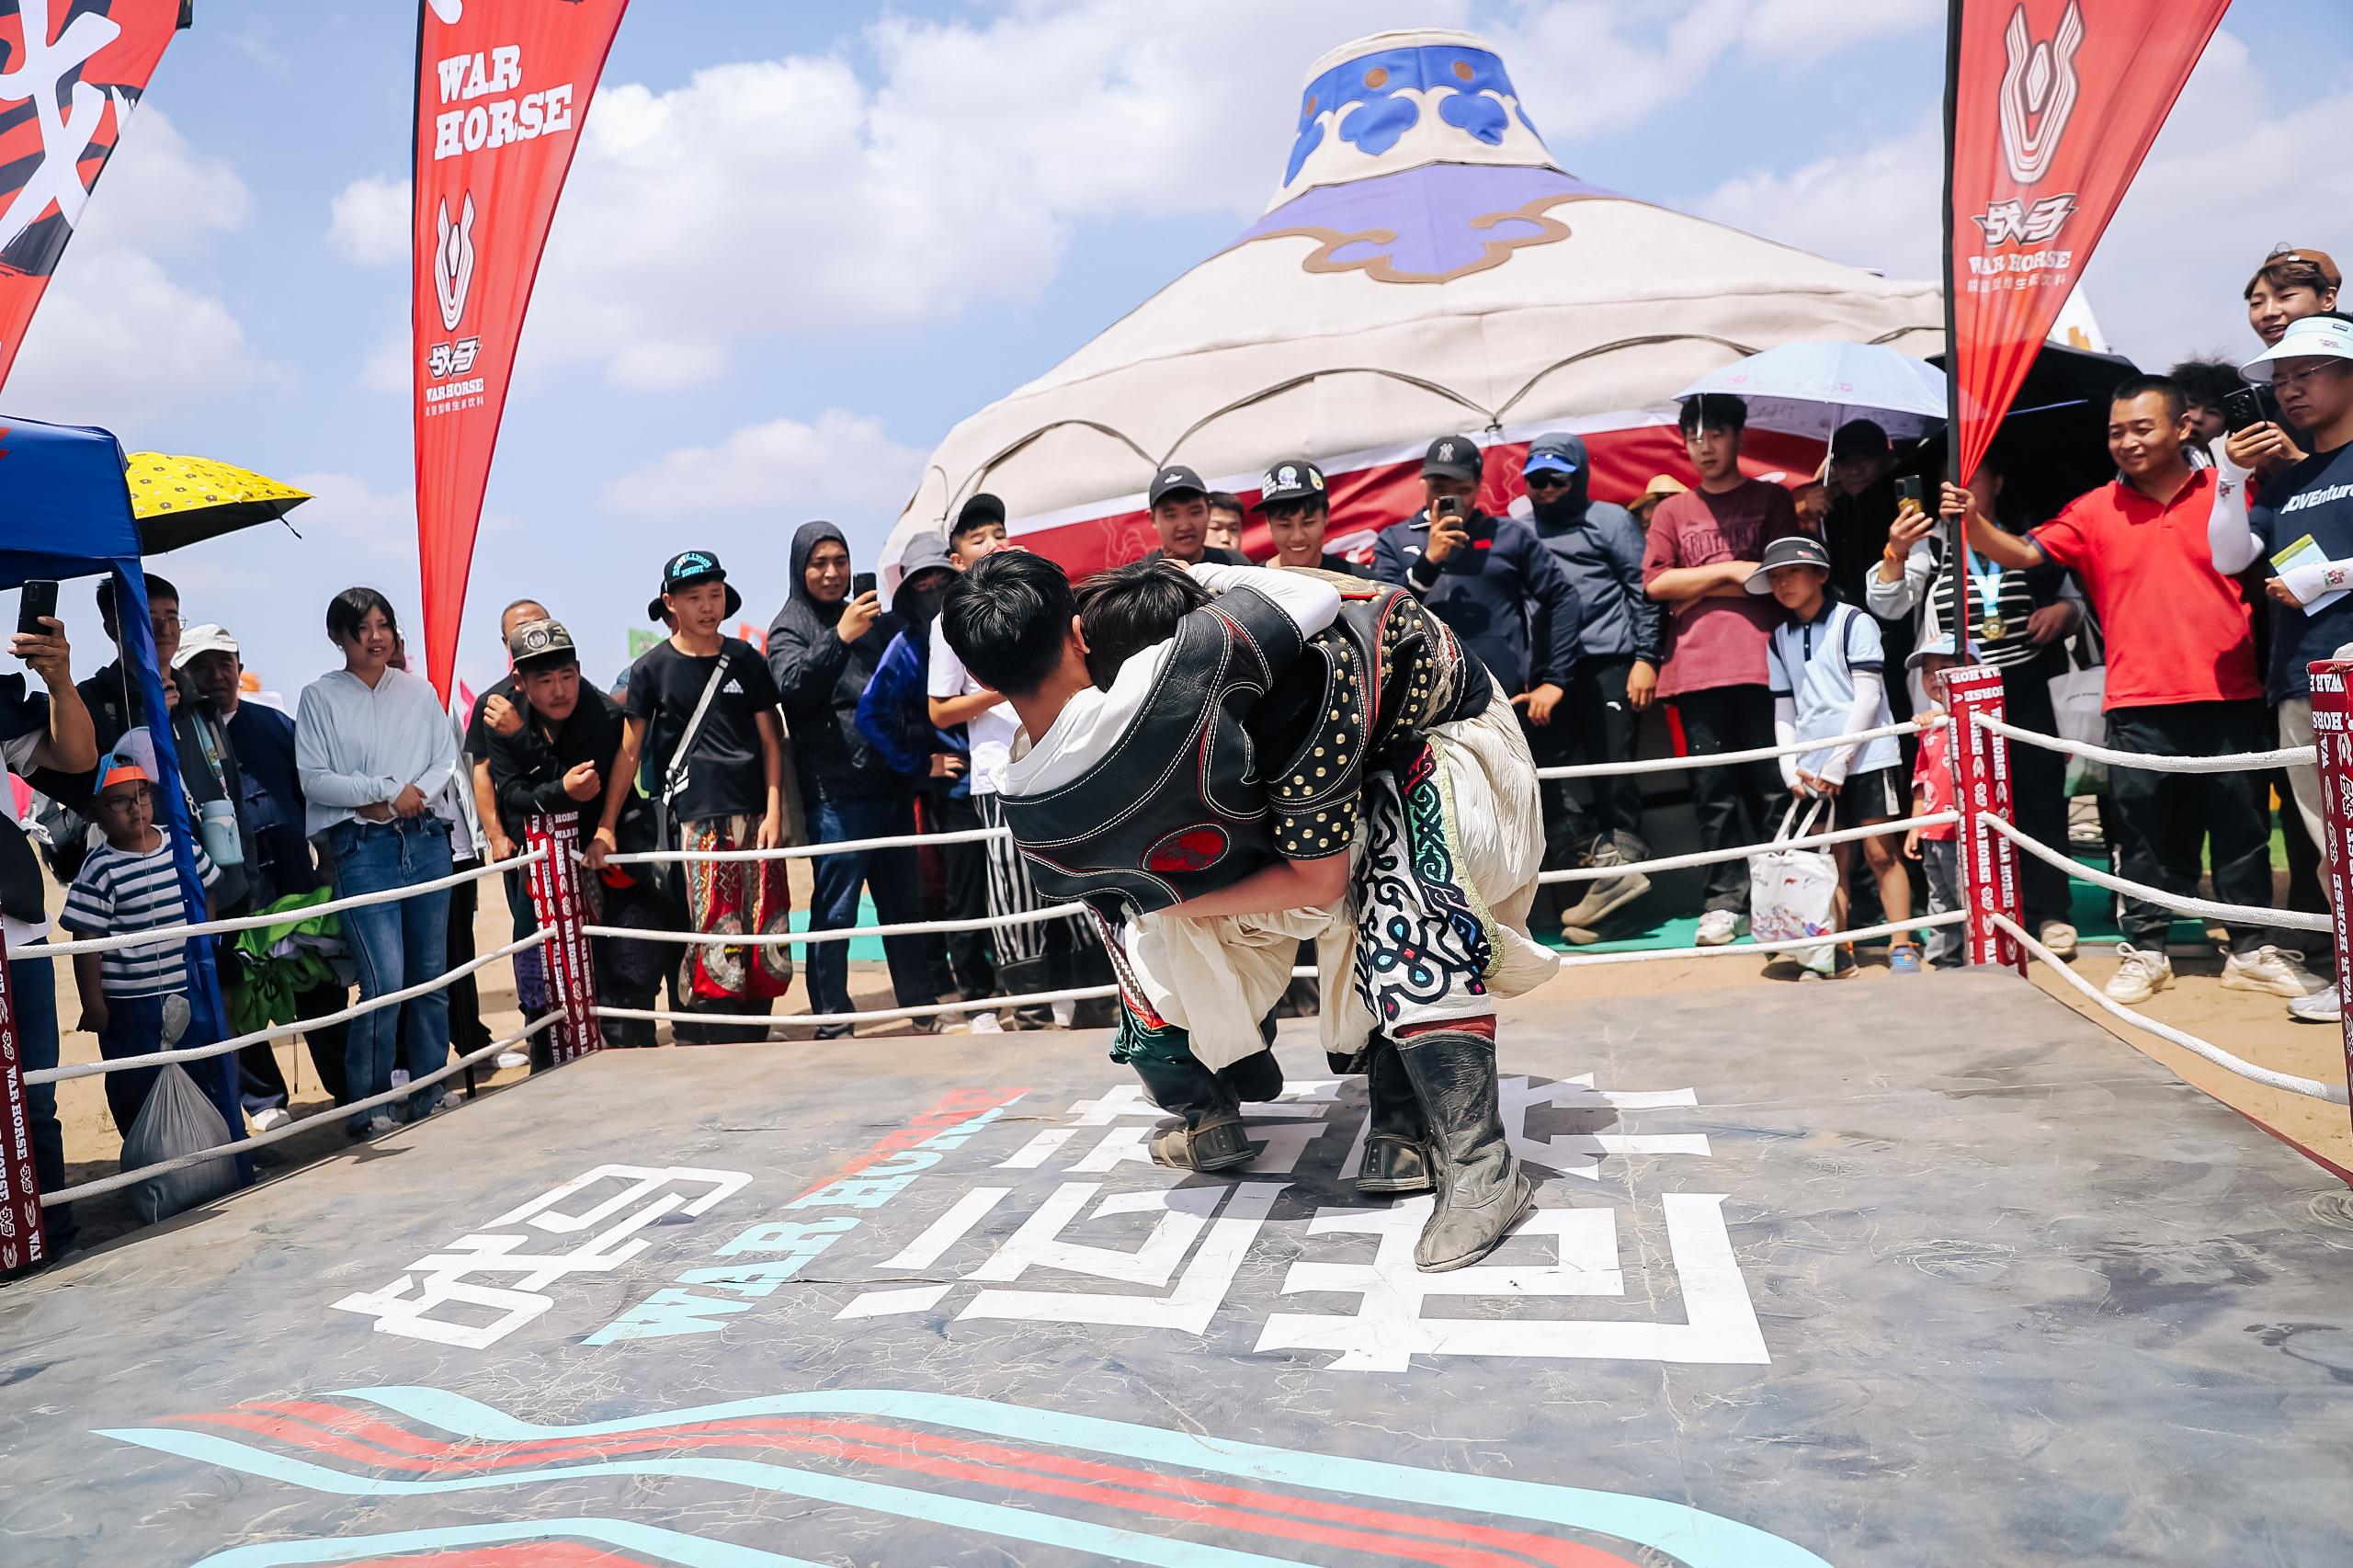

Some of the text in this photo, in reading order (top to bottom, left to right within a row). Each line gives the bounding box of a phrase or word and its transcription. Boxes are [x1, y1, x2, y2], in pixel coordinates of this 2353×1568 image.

[438, 44, 522, 105] WAR
[435, 83, 574, 161] HORSE
[1970, 192, 2079, 249] 战马
[1968, 250, 2073, 276] WAR HORSE
[426, 335, 483, 380] 战马
[445, 378, 484, 399] HORSE
[1992, 735, 2006, 780] HORSE
[2320, 733, 2330, 769] WA
[1977, 838, 1992, 884] HORSE
[2000, 864, 2015, 908] HORSE
[2332, 873, 2349, 953] HORSE
[564, 918, 579, 979] WAR HORSE
[583, 961, 593, 997] HORSE
[2341, 956, 2353, 1005] WAR
[6, 1065, 28, 1161] WAR HORSE
[581, 1087, 1031, 1347] WAR HORSE
[329, 1164, 754, 1350] 战马
